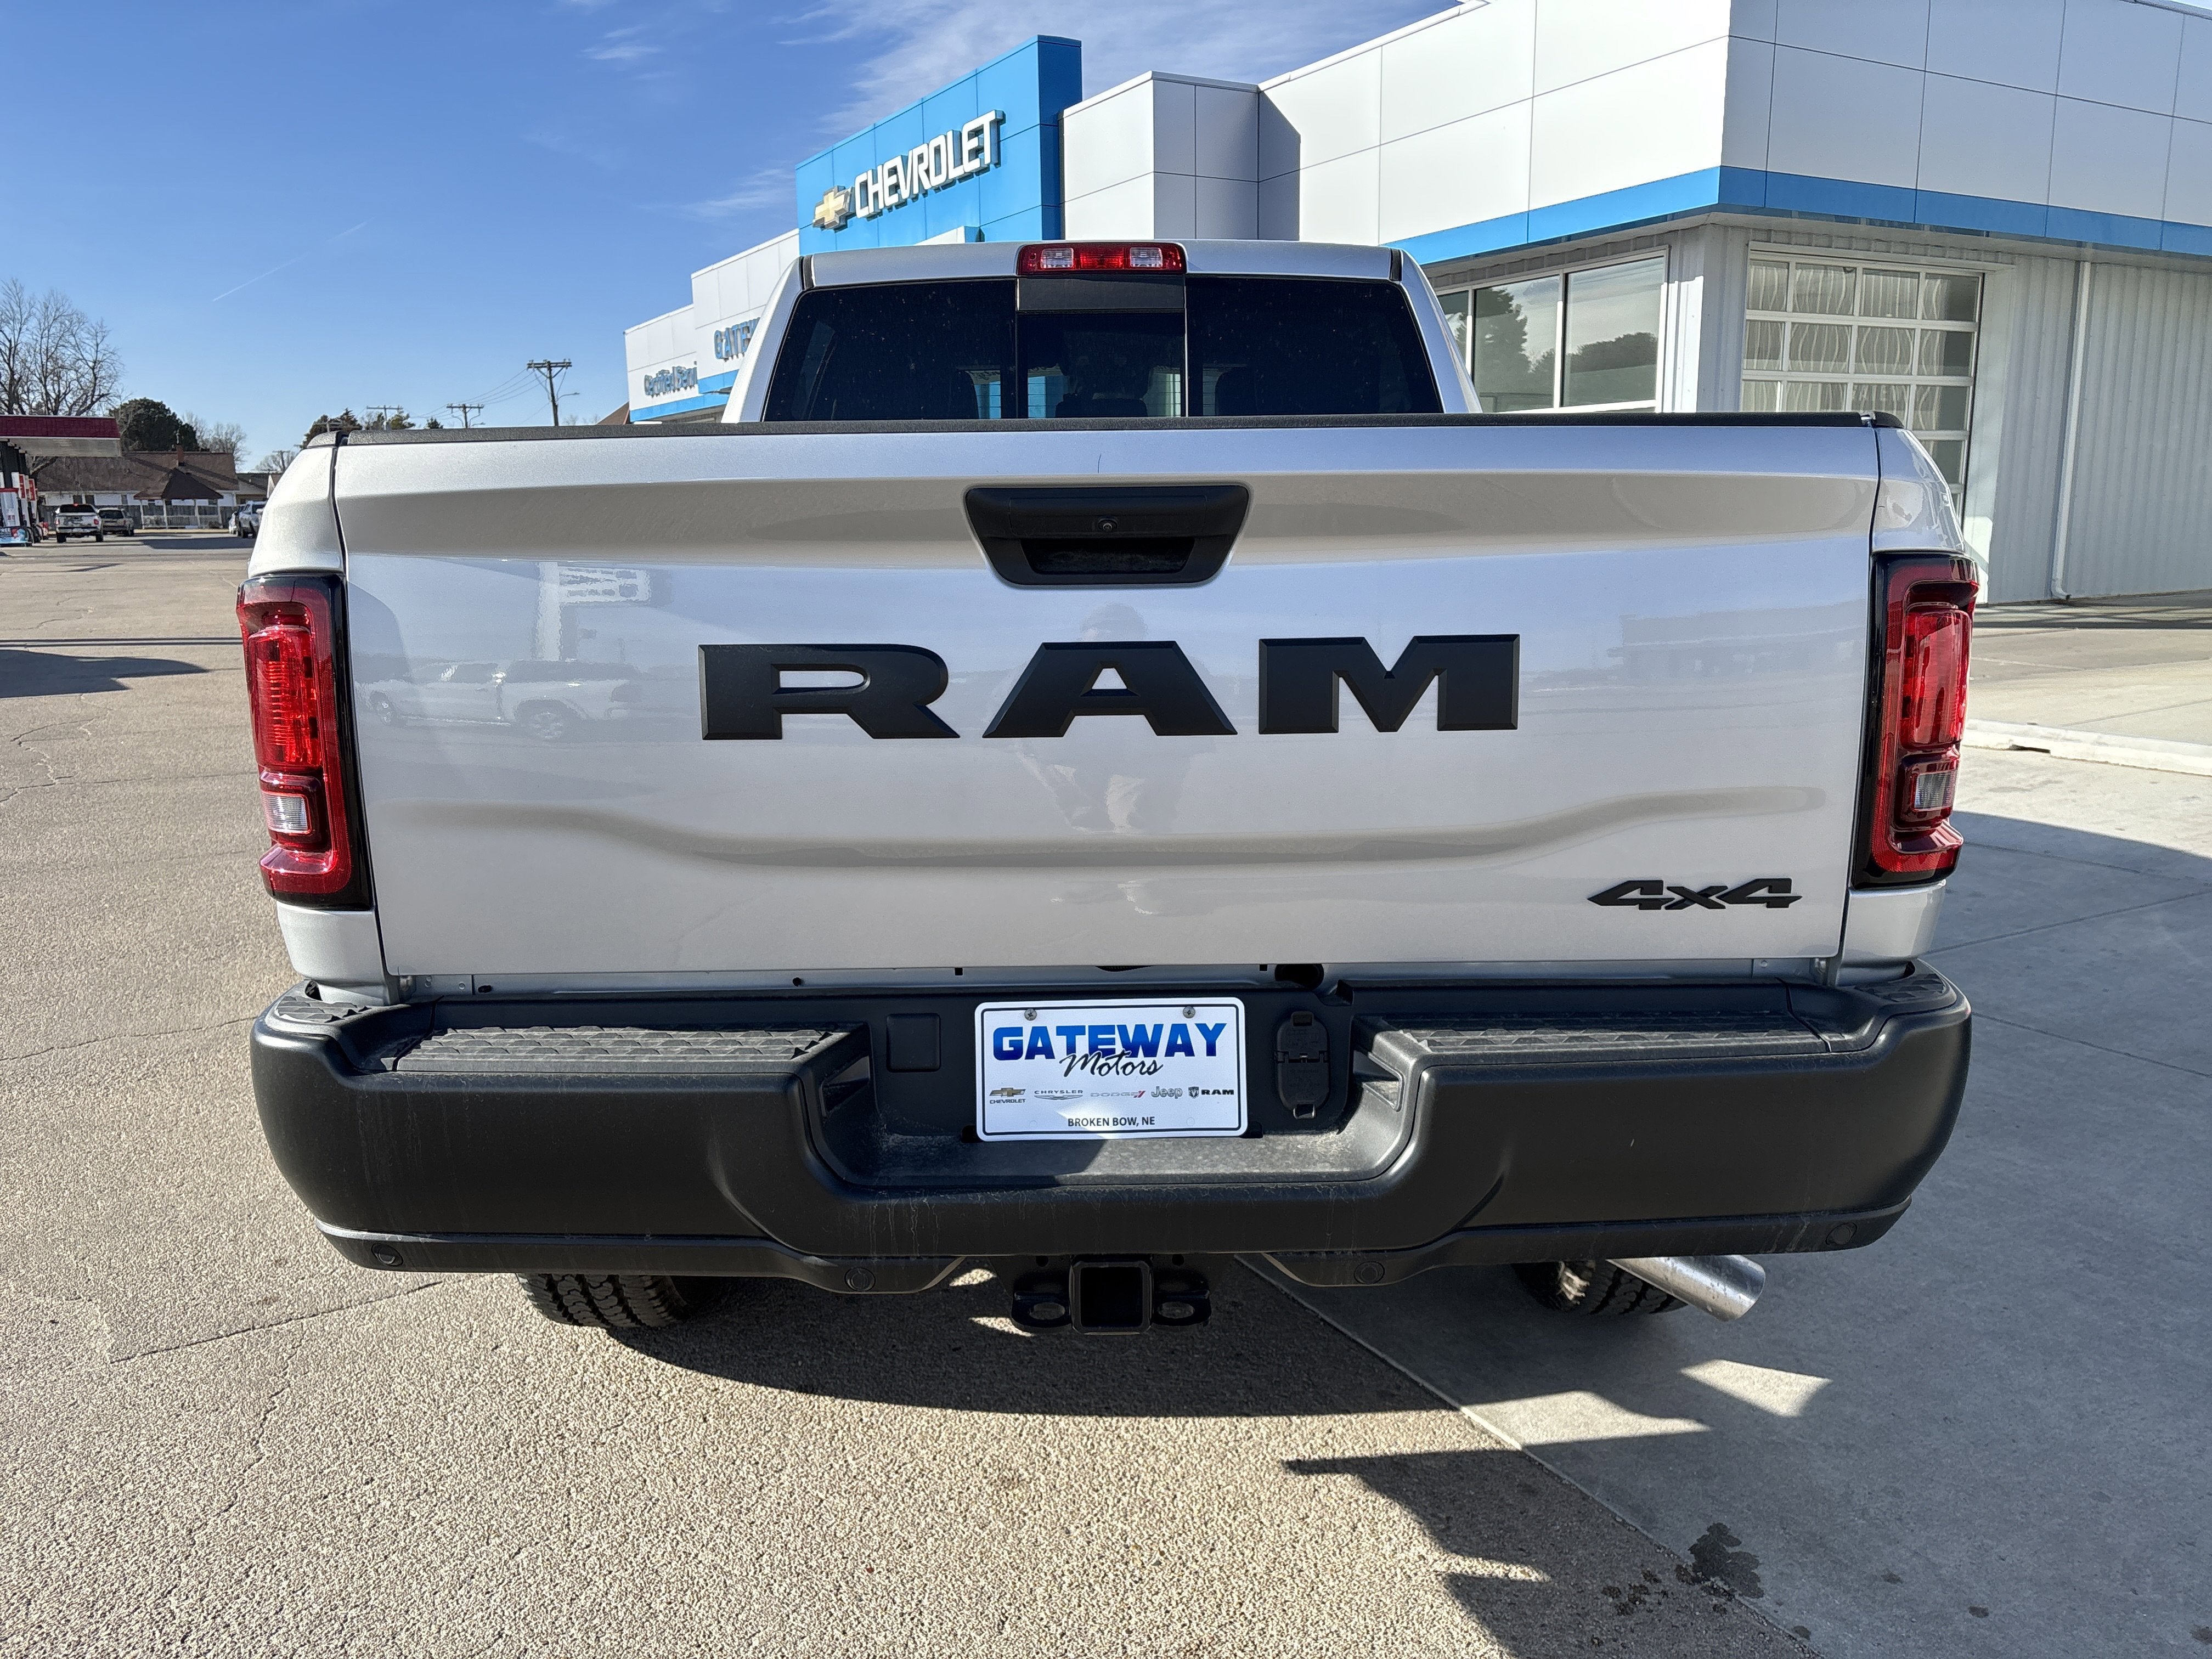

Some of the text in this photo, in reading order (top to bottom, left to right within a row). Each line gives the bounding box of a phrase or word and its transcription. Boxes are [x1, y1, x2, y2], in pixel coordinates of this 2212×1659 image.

[855, 109, 1004, 219] CHEVROLET
[698, 634, 1520, 740] RAM
[1587, 878, 1803, 910] 4x4
[993, 1023, 1227, 1061] GATEWAY
[1059, 1049, 1164, 1077] Motors
[1150, 1086, 1183, 1099] Jeep
[1067, 1116, 1155, 1127] BROKEN BOW, NE
